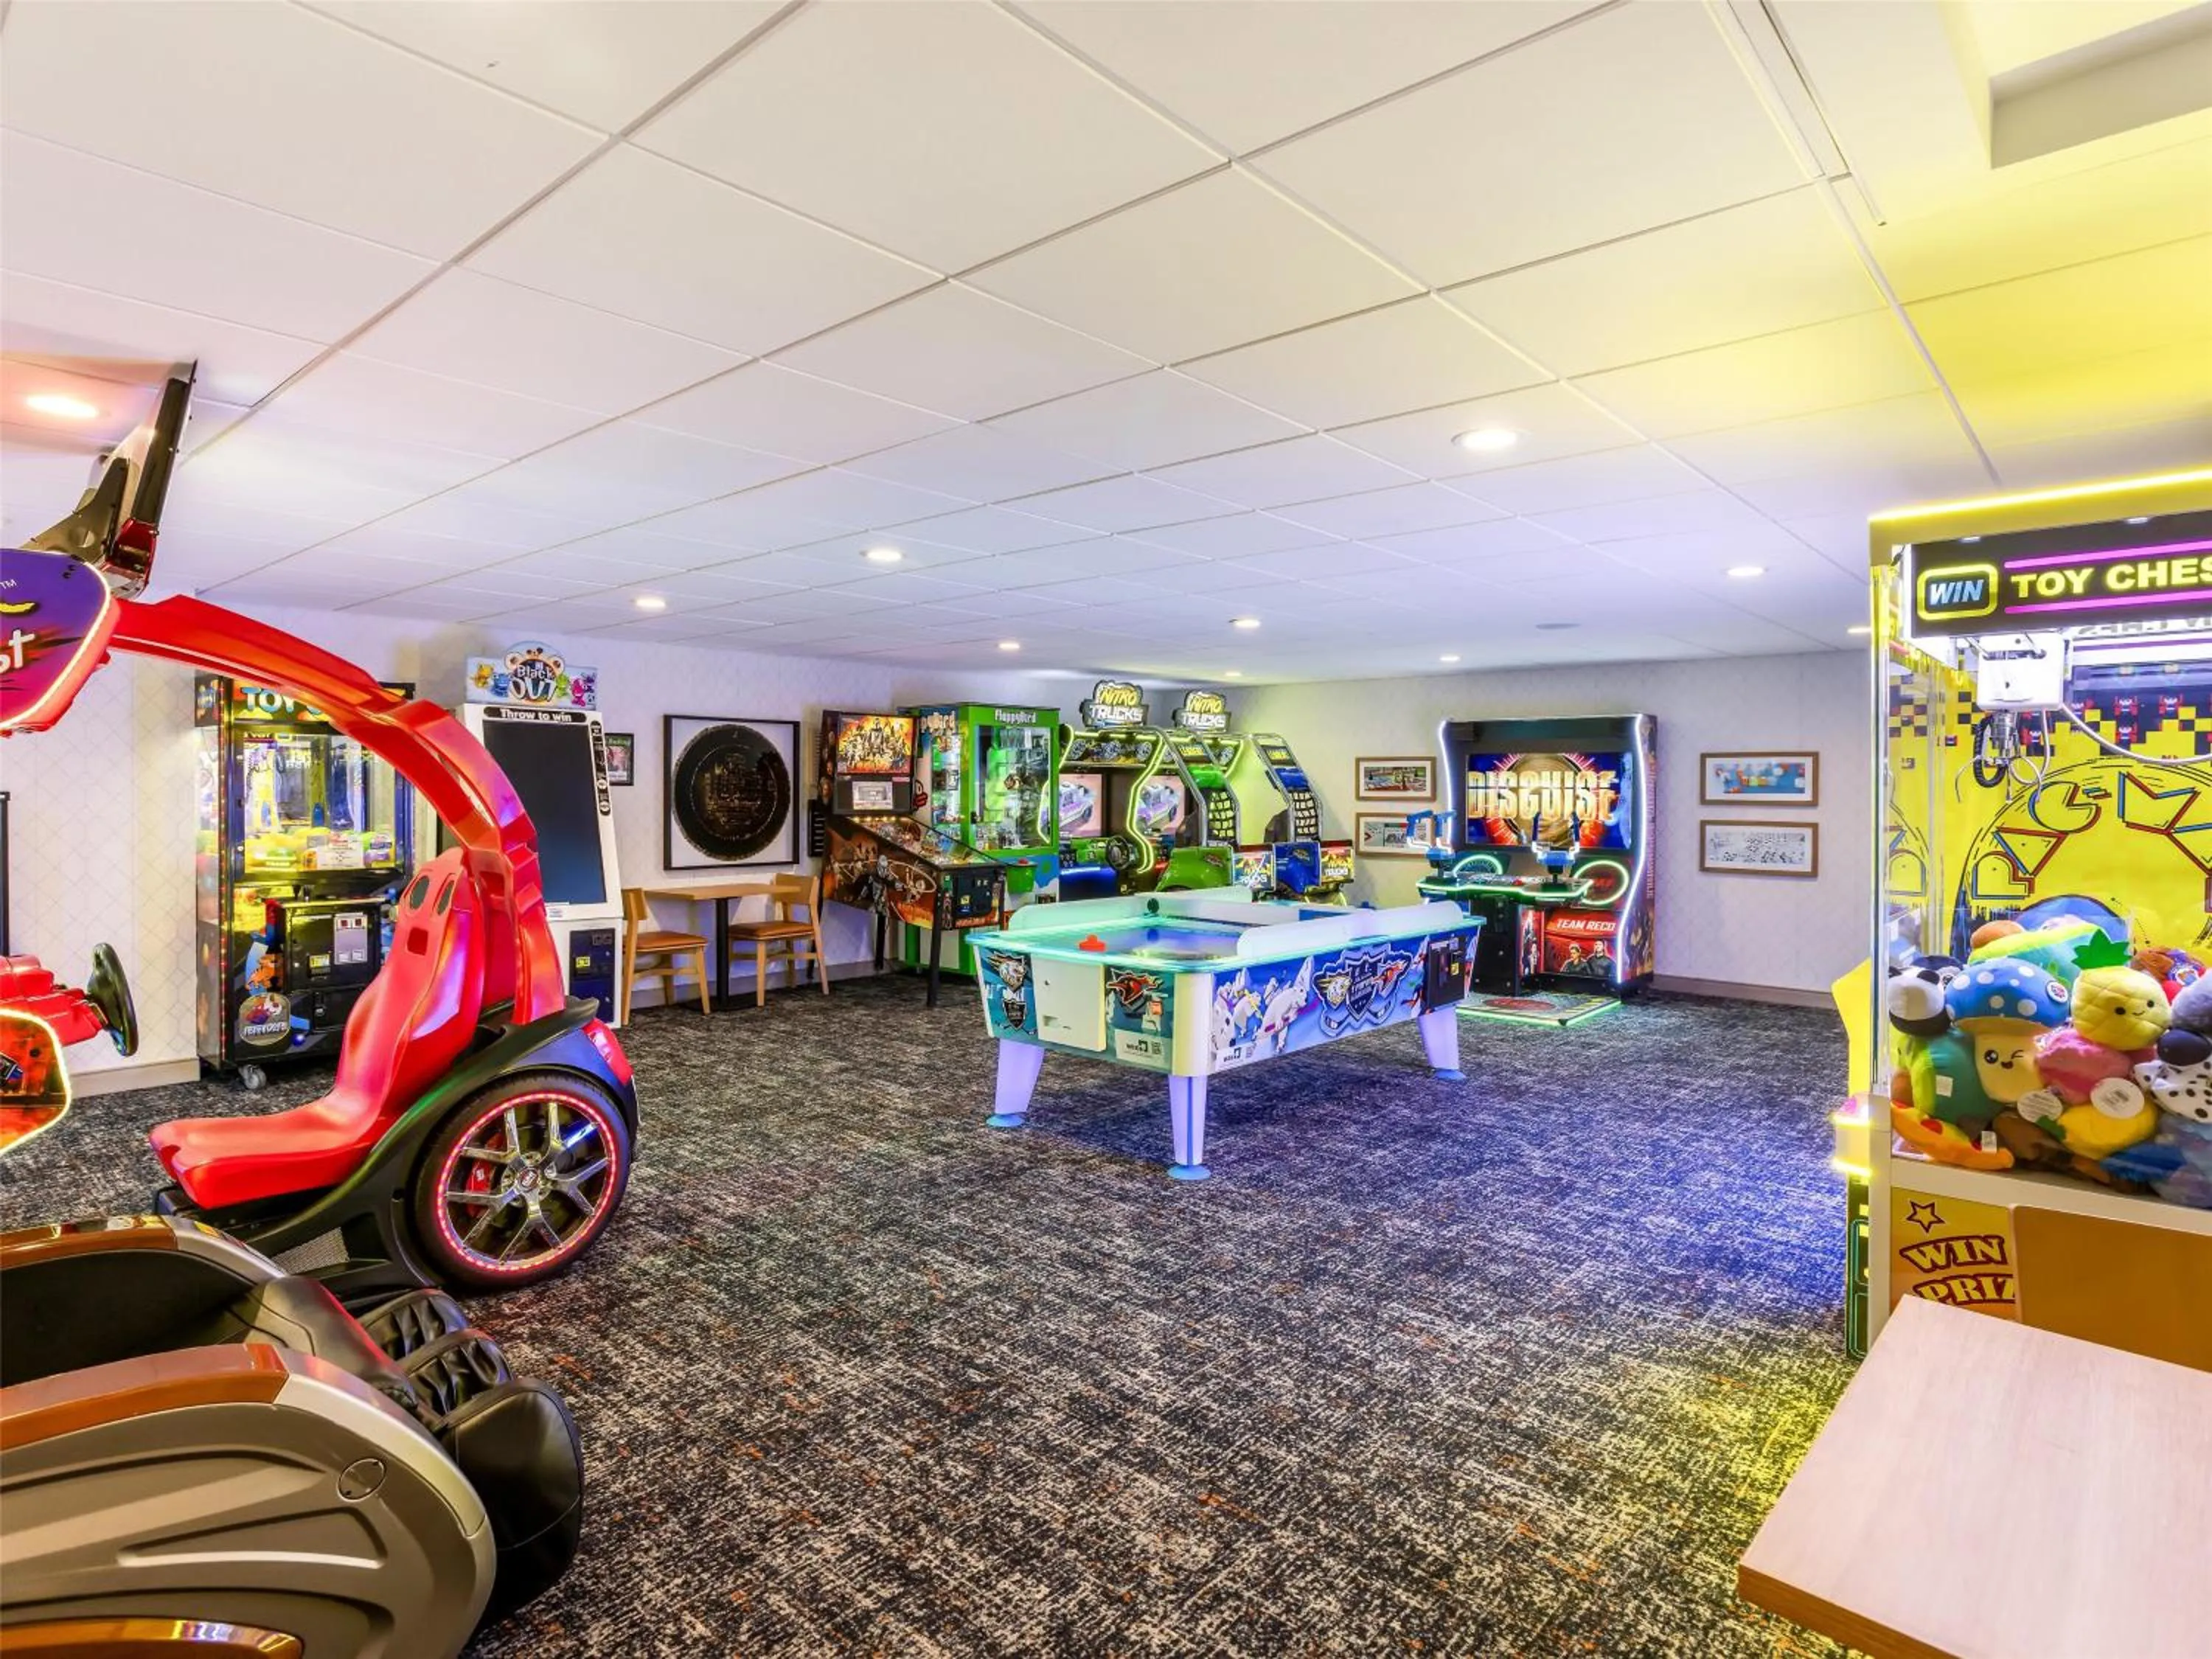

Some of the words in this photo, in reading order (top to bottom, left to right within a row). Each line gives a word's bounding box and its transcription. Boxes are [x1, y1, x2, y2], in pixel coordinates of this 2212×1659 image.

[1928, 578, 1985, 606] WIN
[2011, 567, 2095, 599] TOY
[517, 664, 554, 680] Black
[240, 686, 294, 714] TOY
[1099, 687, 1138, 706] NITRO
[1189, 695, 1222, 713] NITRO
[500, 708, 535, 720] Throw
[538, 712, 550, 721] to
[553, 711, 572, 723] win
[1090, 704, 1143, 722] TRUCKS
[1181, 712, 1225, 728] TRUCKS
[1467, 770, 1618, 821] DISGUISE
[1557, 918, 1585, 930] TEAM
[1900, 1235, 2007, 1273] WIN
